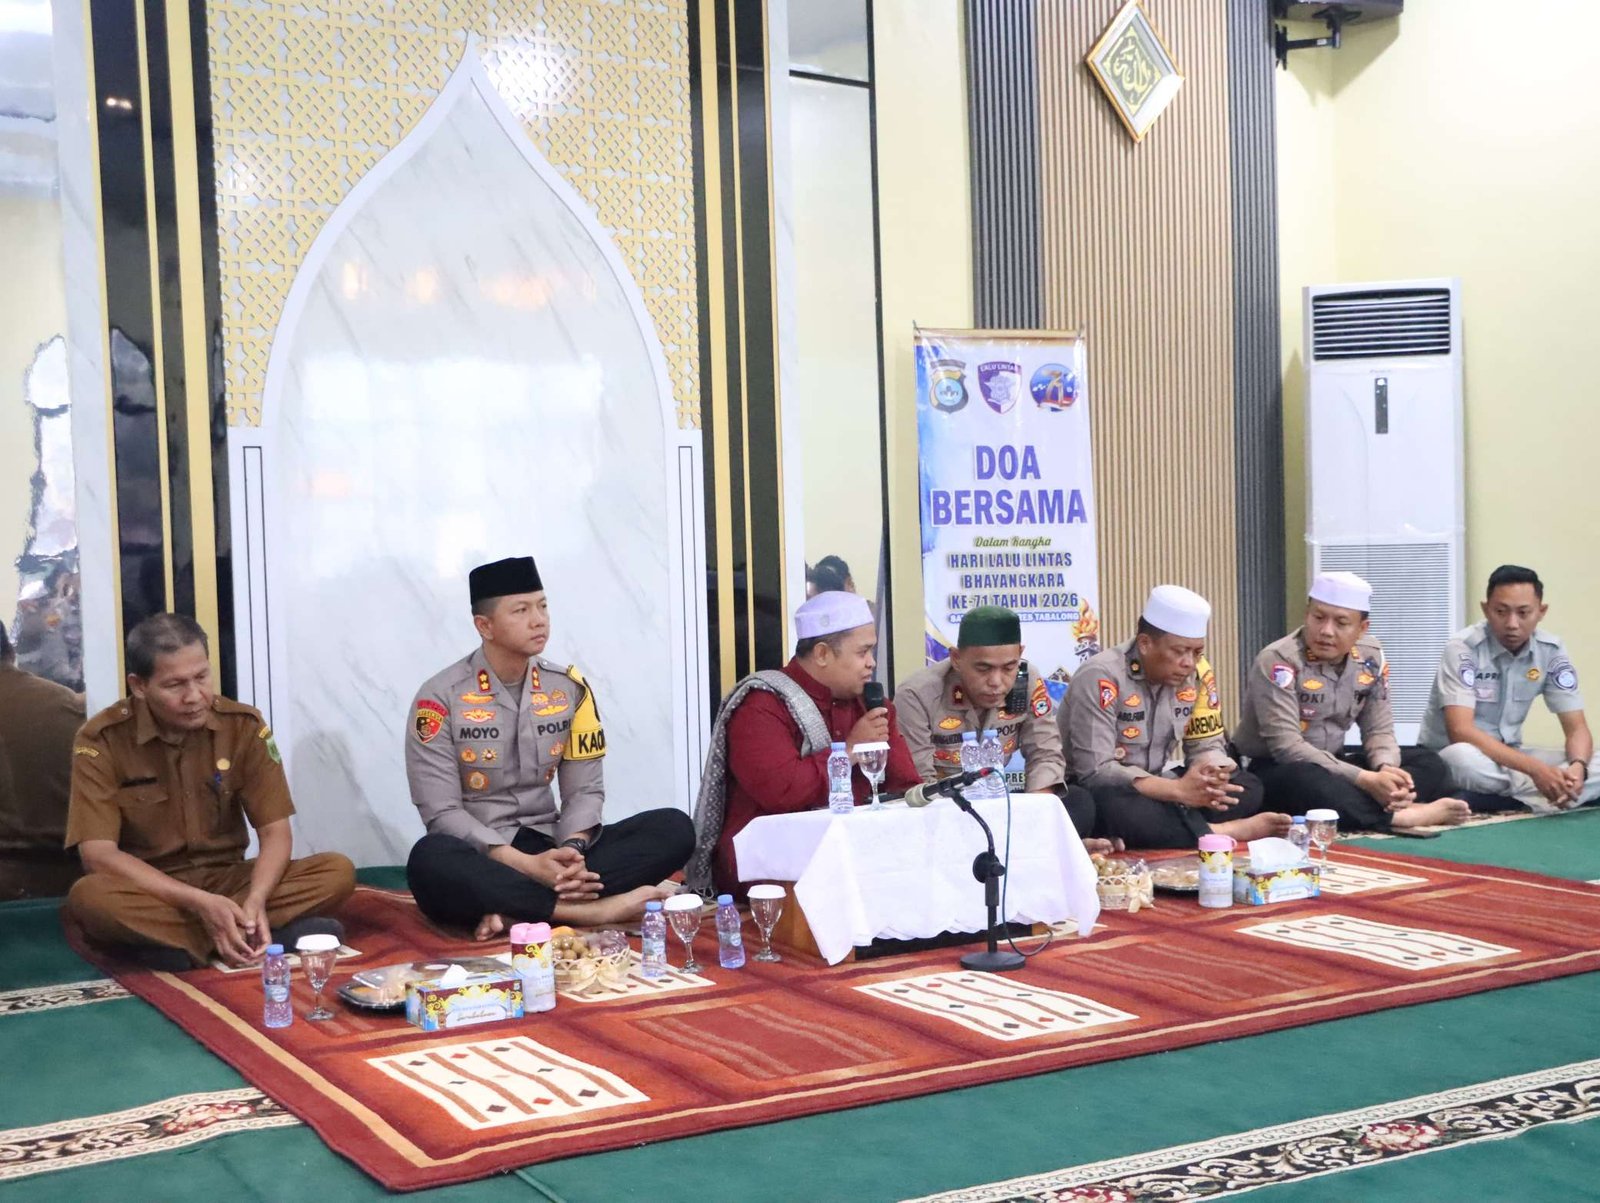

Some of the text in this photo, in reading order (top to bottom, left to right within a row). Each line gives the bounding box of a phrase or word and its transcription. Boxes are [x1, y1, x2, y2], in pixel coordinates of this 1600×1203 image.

[976, 445, 1041, 480] DOA
[932, 489, 1087, 525] BERSAMA
[975, 536, 1051, 549] Dalam Rangka
[950, 553, 1072, 568] HARI LALU LINTAS
[963, 573, 1065, 588] BHAYANGKARA
[951, 593, 1079, 609] KE-71 TAHUN 2026
[1035, 612, 1080, 622] TABALONG
[459, 727, 499, 739] MOYO
